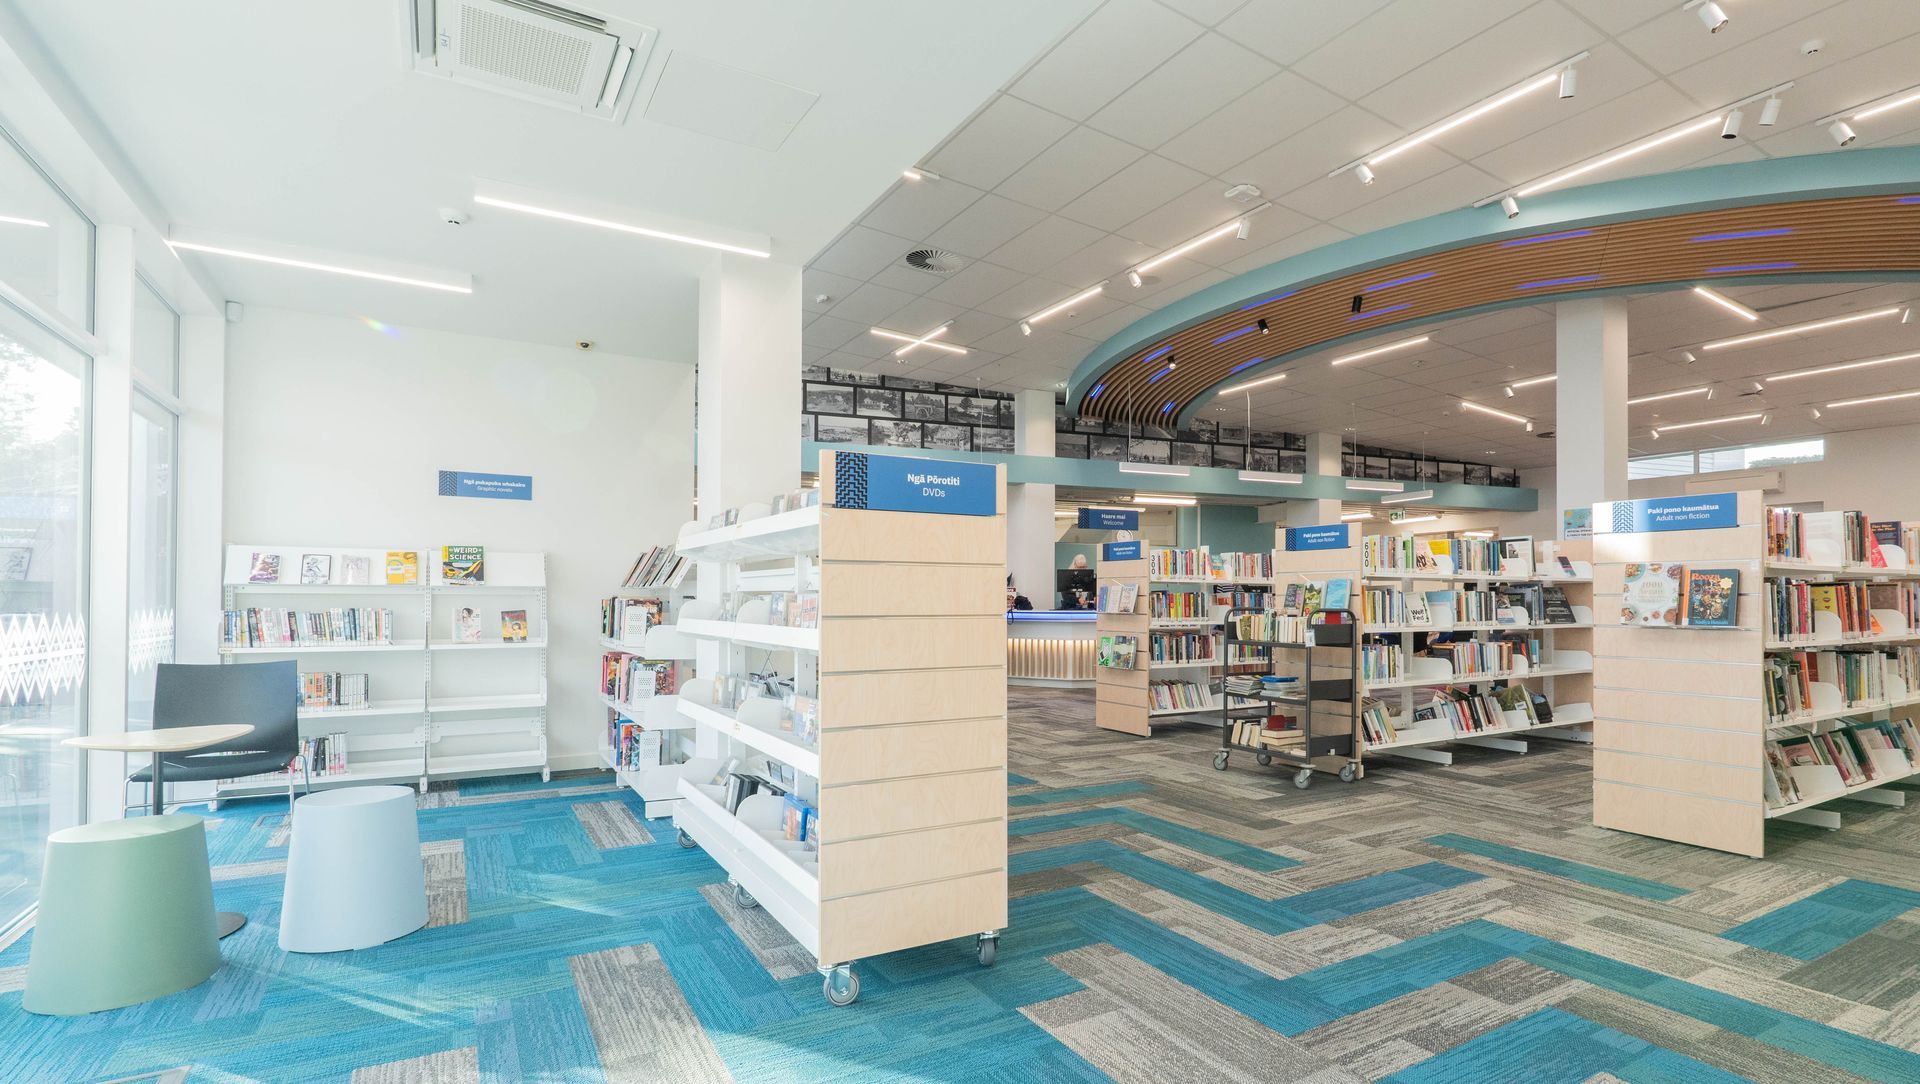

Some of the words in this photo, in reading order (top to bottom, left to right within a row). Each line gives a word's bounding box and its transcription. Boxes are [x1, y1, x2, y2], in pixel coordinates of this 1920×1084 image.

[907, 474, 925, 484] Ngā
[927, 475, 960, 485] Pōrotiti
[923, 488, 945, 497] DVDs
